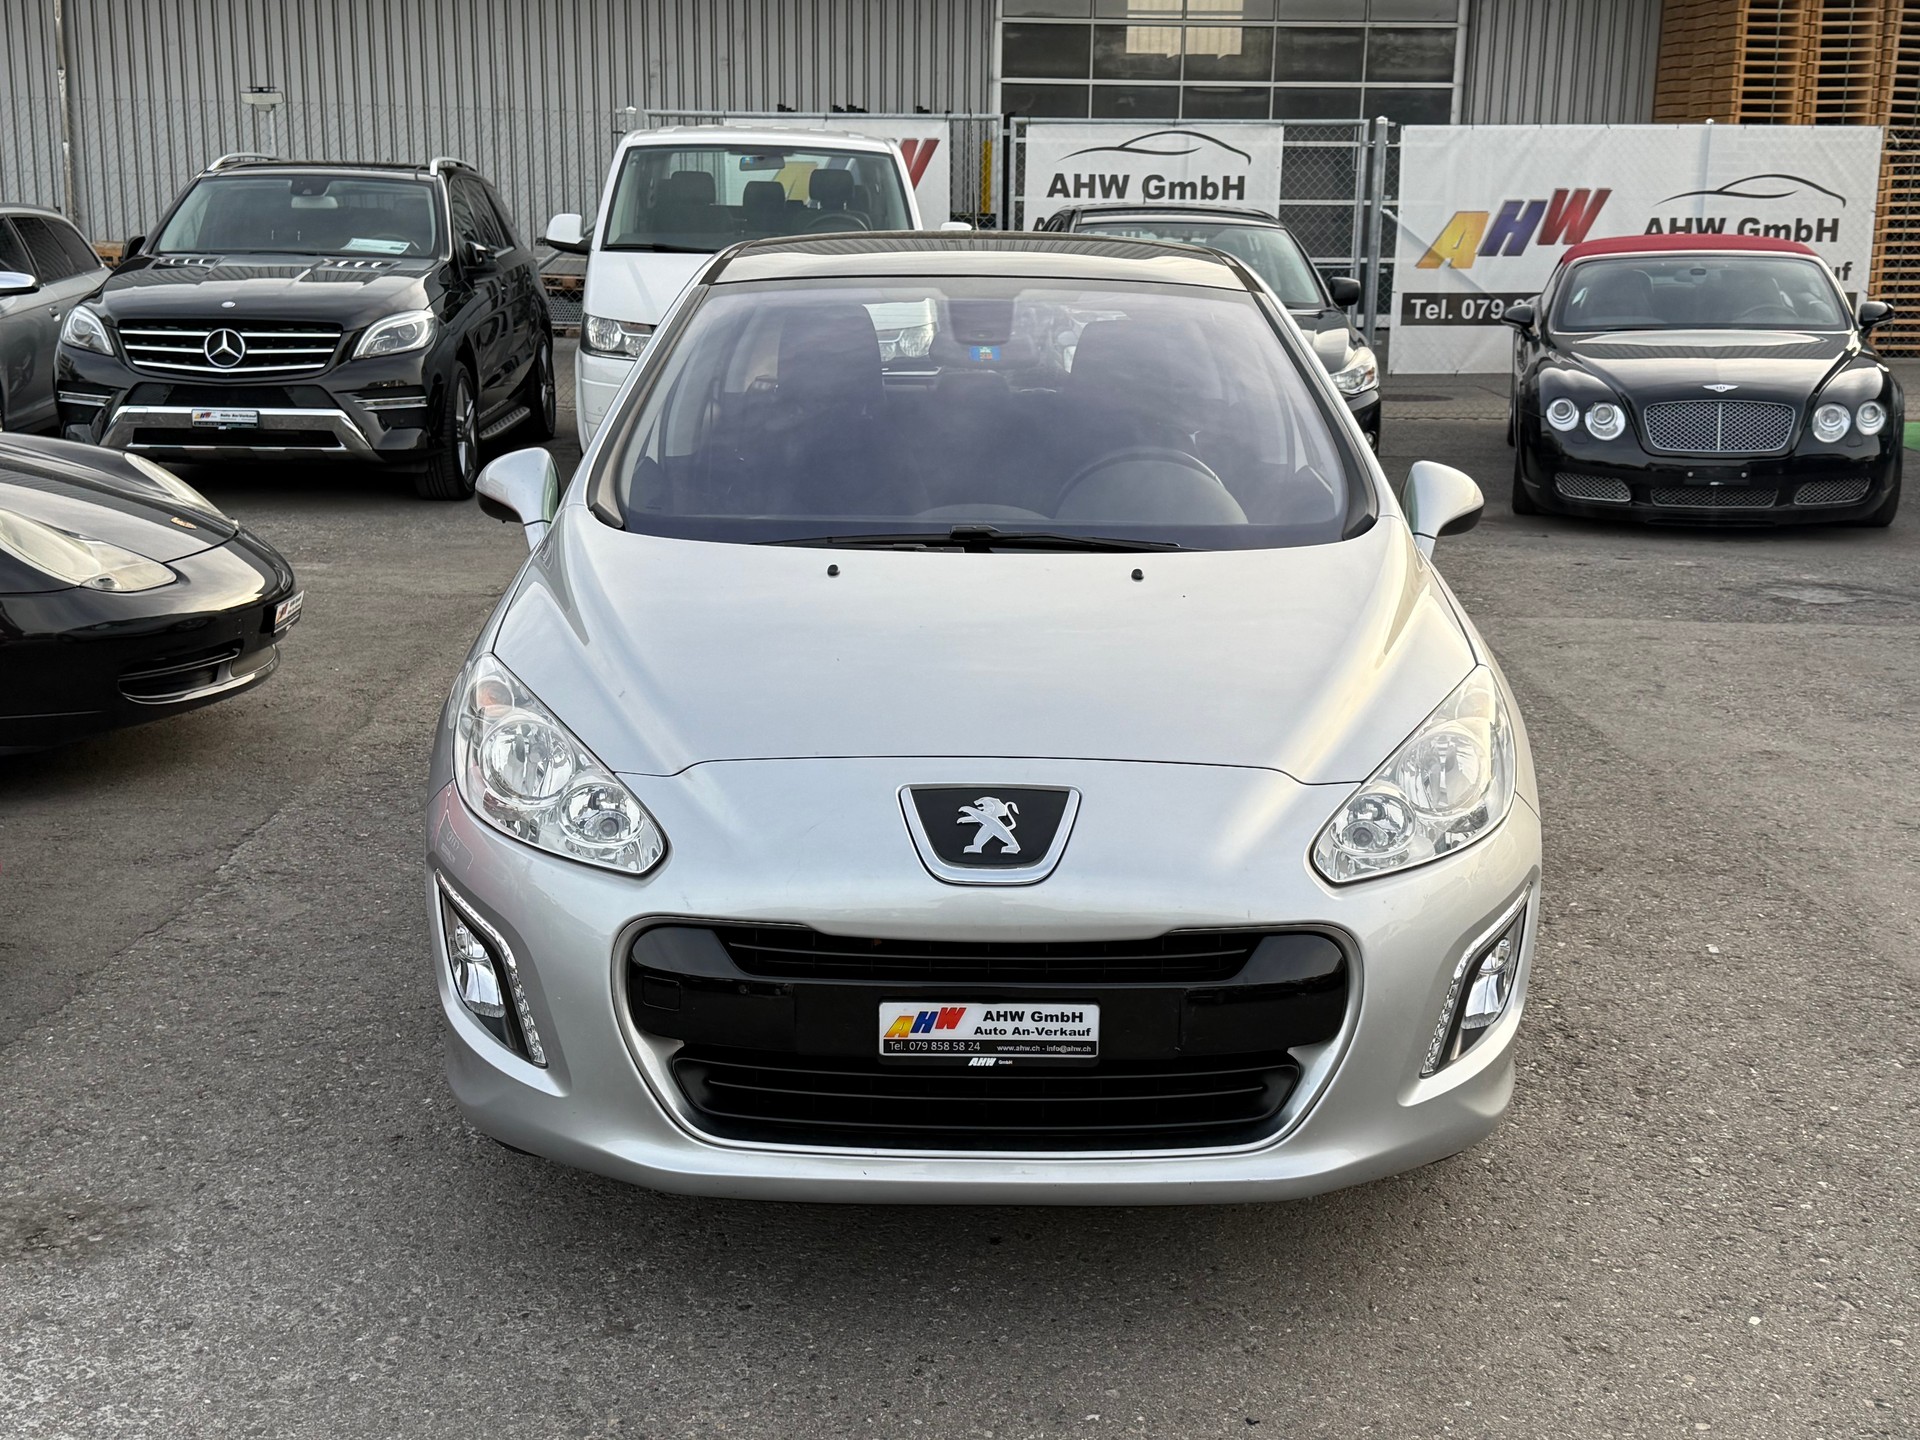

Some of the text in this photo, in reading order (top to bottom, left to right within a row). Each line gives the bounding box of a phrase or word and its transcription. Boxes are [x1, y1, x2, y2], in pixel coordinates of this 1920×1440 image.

[1046, 173, 1246, 200] AHW GmbH
[1415, 188, 1613, 269] AHW
[1644, 217, 1840, 242] AHW GmbH
[1410, 299, 1453, 319] Tel.
[1461, 299, 1505, 320] 079
[884, 1007, 967, 1038] AHW
[983, 1010, 1084, 1023] AHW GmbH
[974, 1026, 1092, 1037] Auto An-Verkauf
[889, 1041, 981, 1051] Tel. 079 858 58 24
[996, 1044, 1041, 1053] www.ahw.ch
[968, 1057, 997, 1067] AHW
